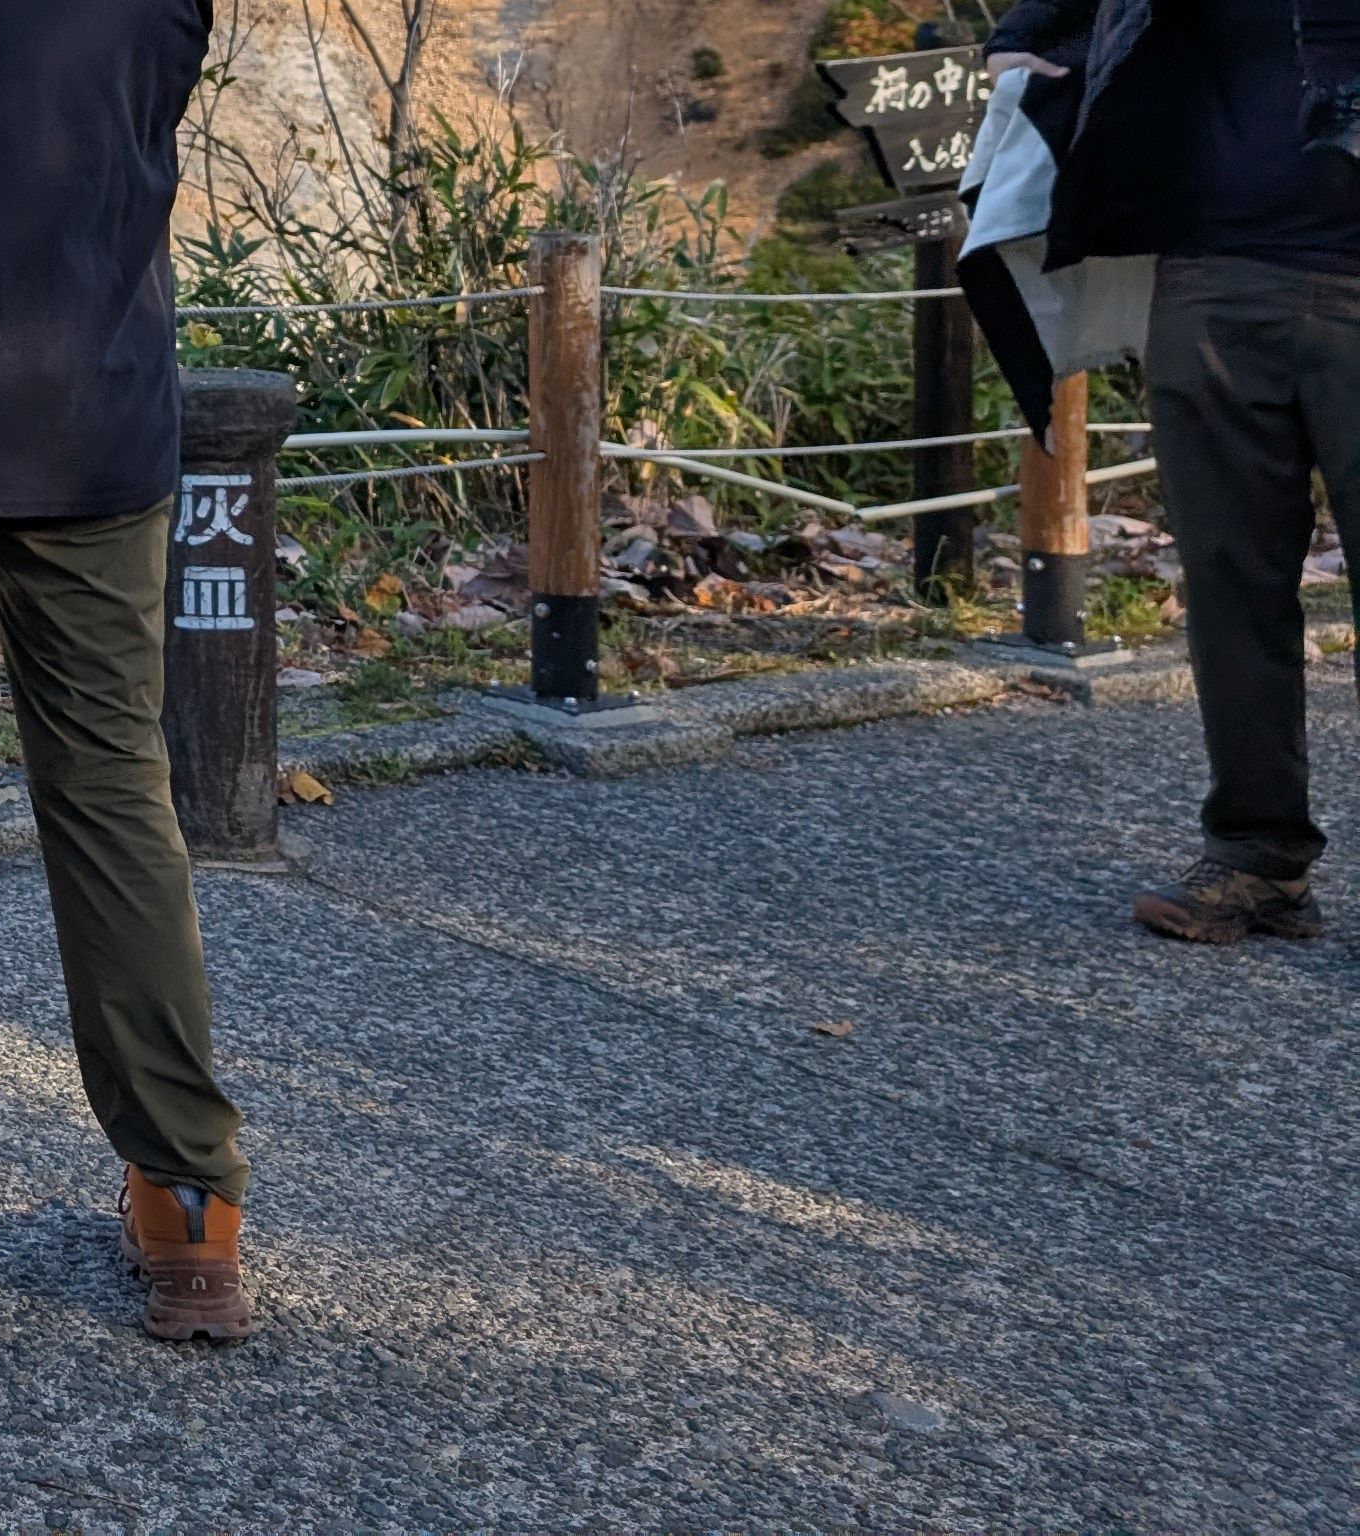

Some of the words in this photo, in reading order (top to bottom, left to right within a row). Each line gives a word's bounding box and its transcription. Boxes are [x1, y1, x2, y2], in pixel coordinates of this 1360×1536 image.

[902, 130, 974, 173] 入らな
[174, 474, 254, 629] 灰皿
